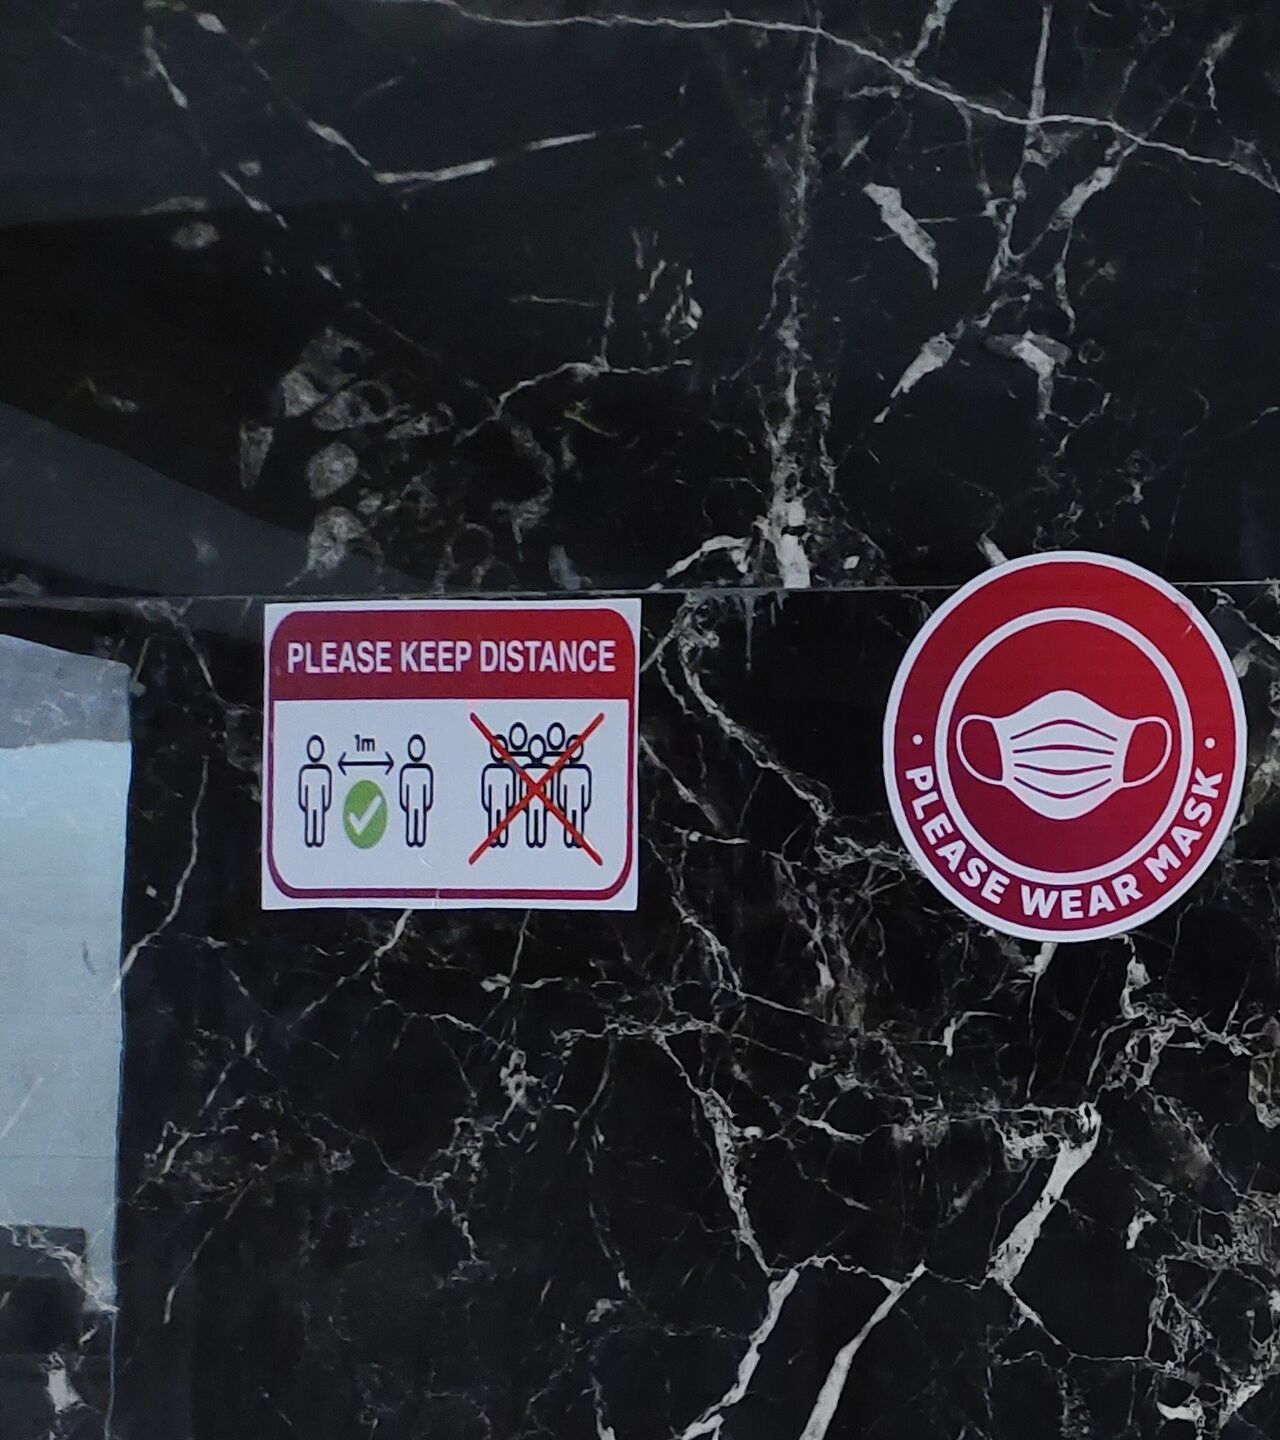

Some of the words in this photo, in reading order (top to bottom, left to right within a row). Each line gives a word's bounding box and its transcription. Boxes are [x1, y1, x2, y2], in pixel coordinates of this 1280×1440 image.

[287, 641, 393, 674] PLEASE
[400, 640, 472, 672] KEEP
[479, 640, 616, 672] DISTANCE
[354, 734, 376, 752] 1m
[905, 765, 1010, 904] PLEASE
[1020, 873, 1143, 920] WEAR
[1142, 767, 1223, 884] MASK
